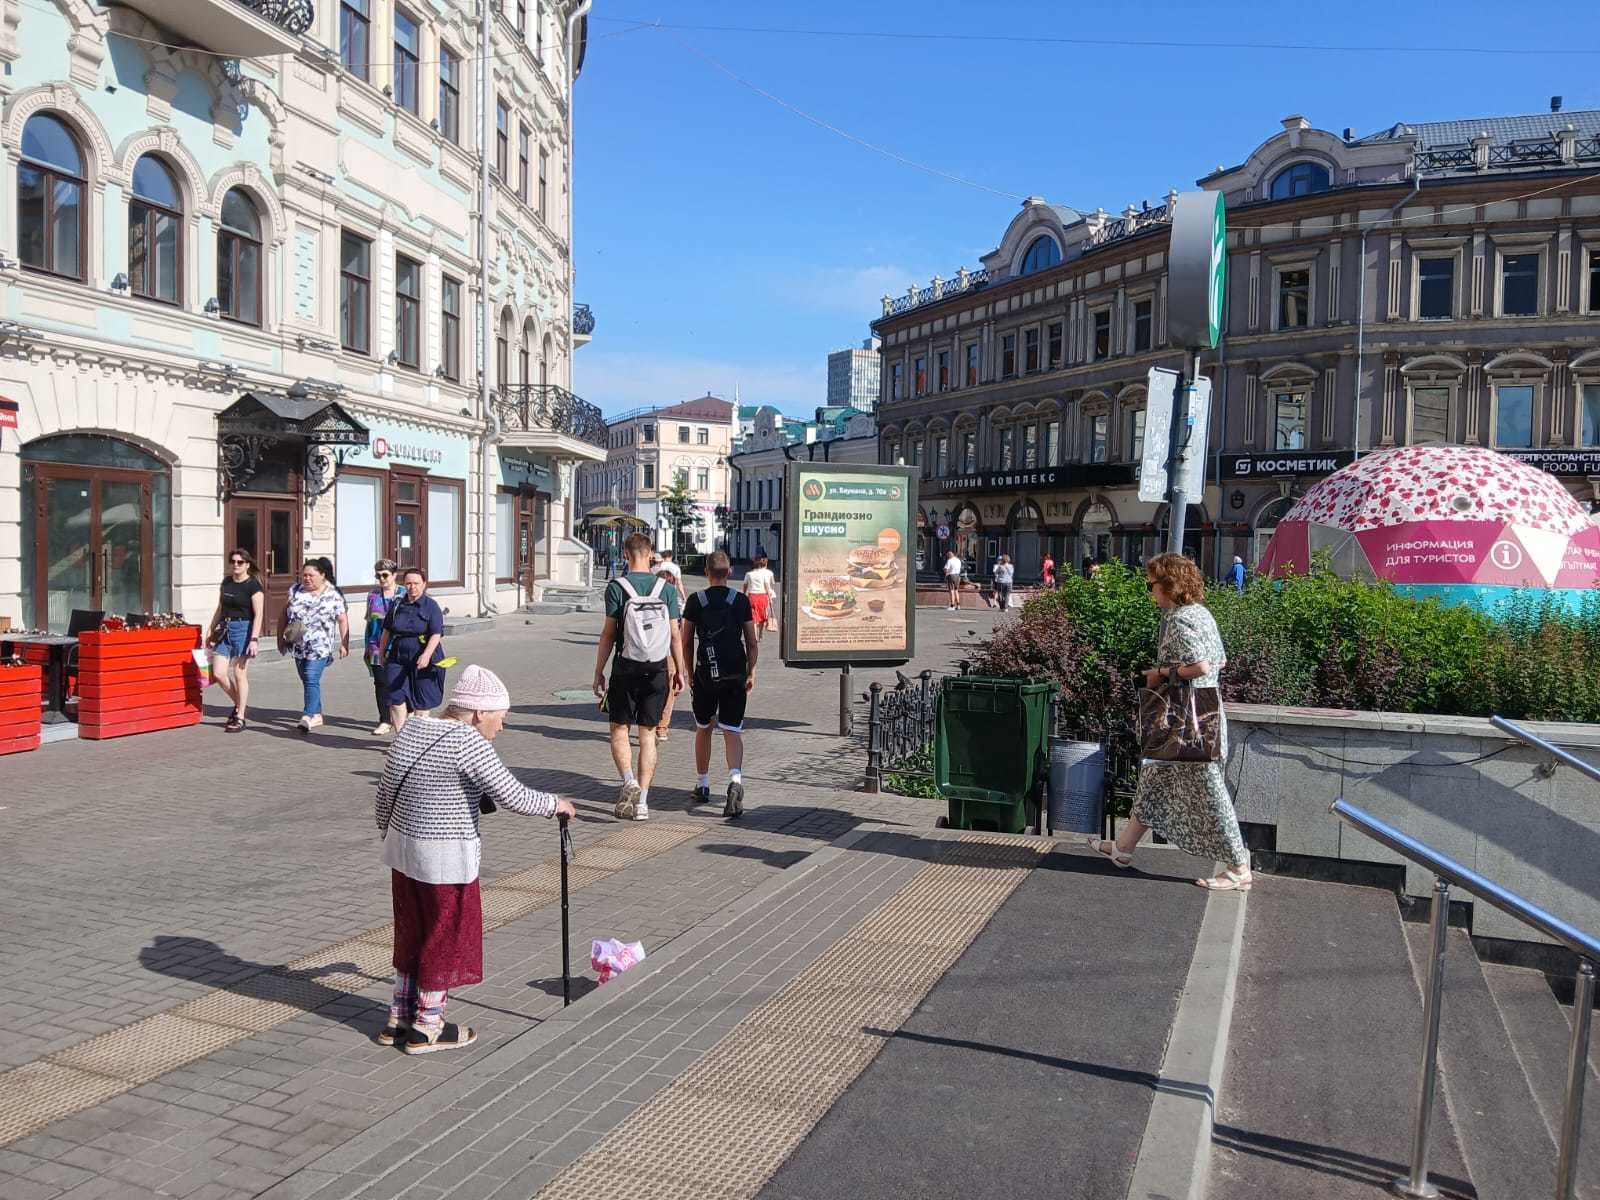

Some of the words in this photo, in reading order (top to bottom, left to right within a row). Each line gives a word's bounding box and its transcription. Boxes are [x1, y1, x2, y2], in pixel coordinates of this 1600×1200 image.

[1256, 459, 1338, 471] КОСМЕТИК
[991, 473, 1056, 487] КОМПЛЕКС
[804, 508, 873, 522] Грандиозно
[803, 525, 845, 536] вкусно
[1386, 540, 1474, 552] ИНФОРМАЦИЯ
[1385, 555, 1411, 568] ДЛЯ
[1413, 553, 1476, 564] ТУРИСТОВ
